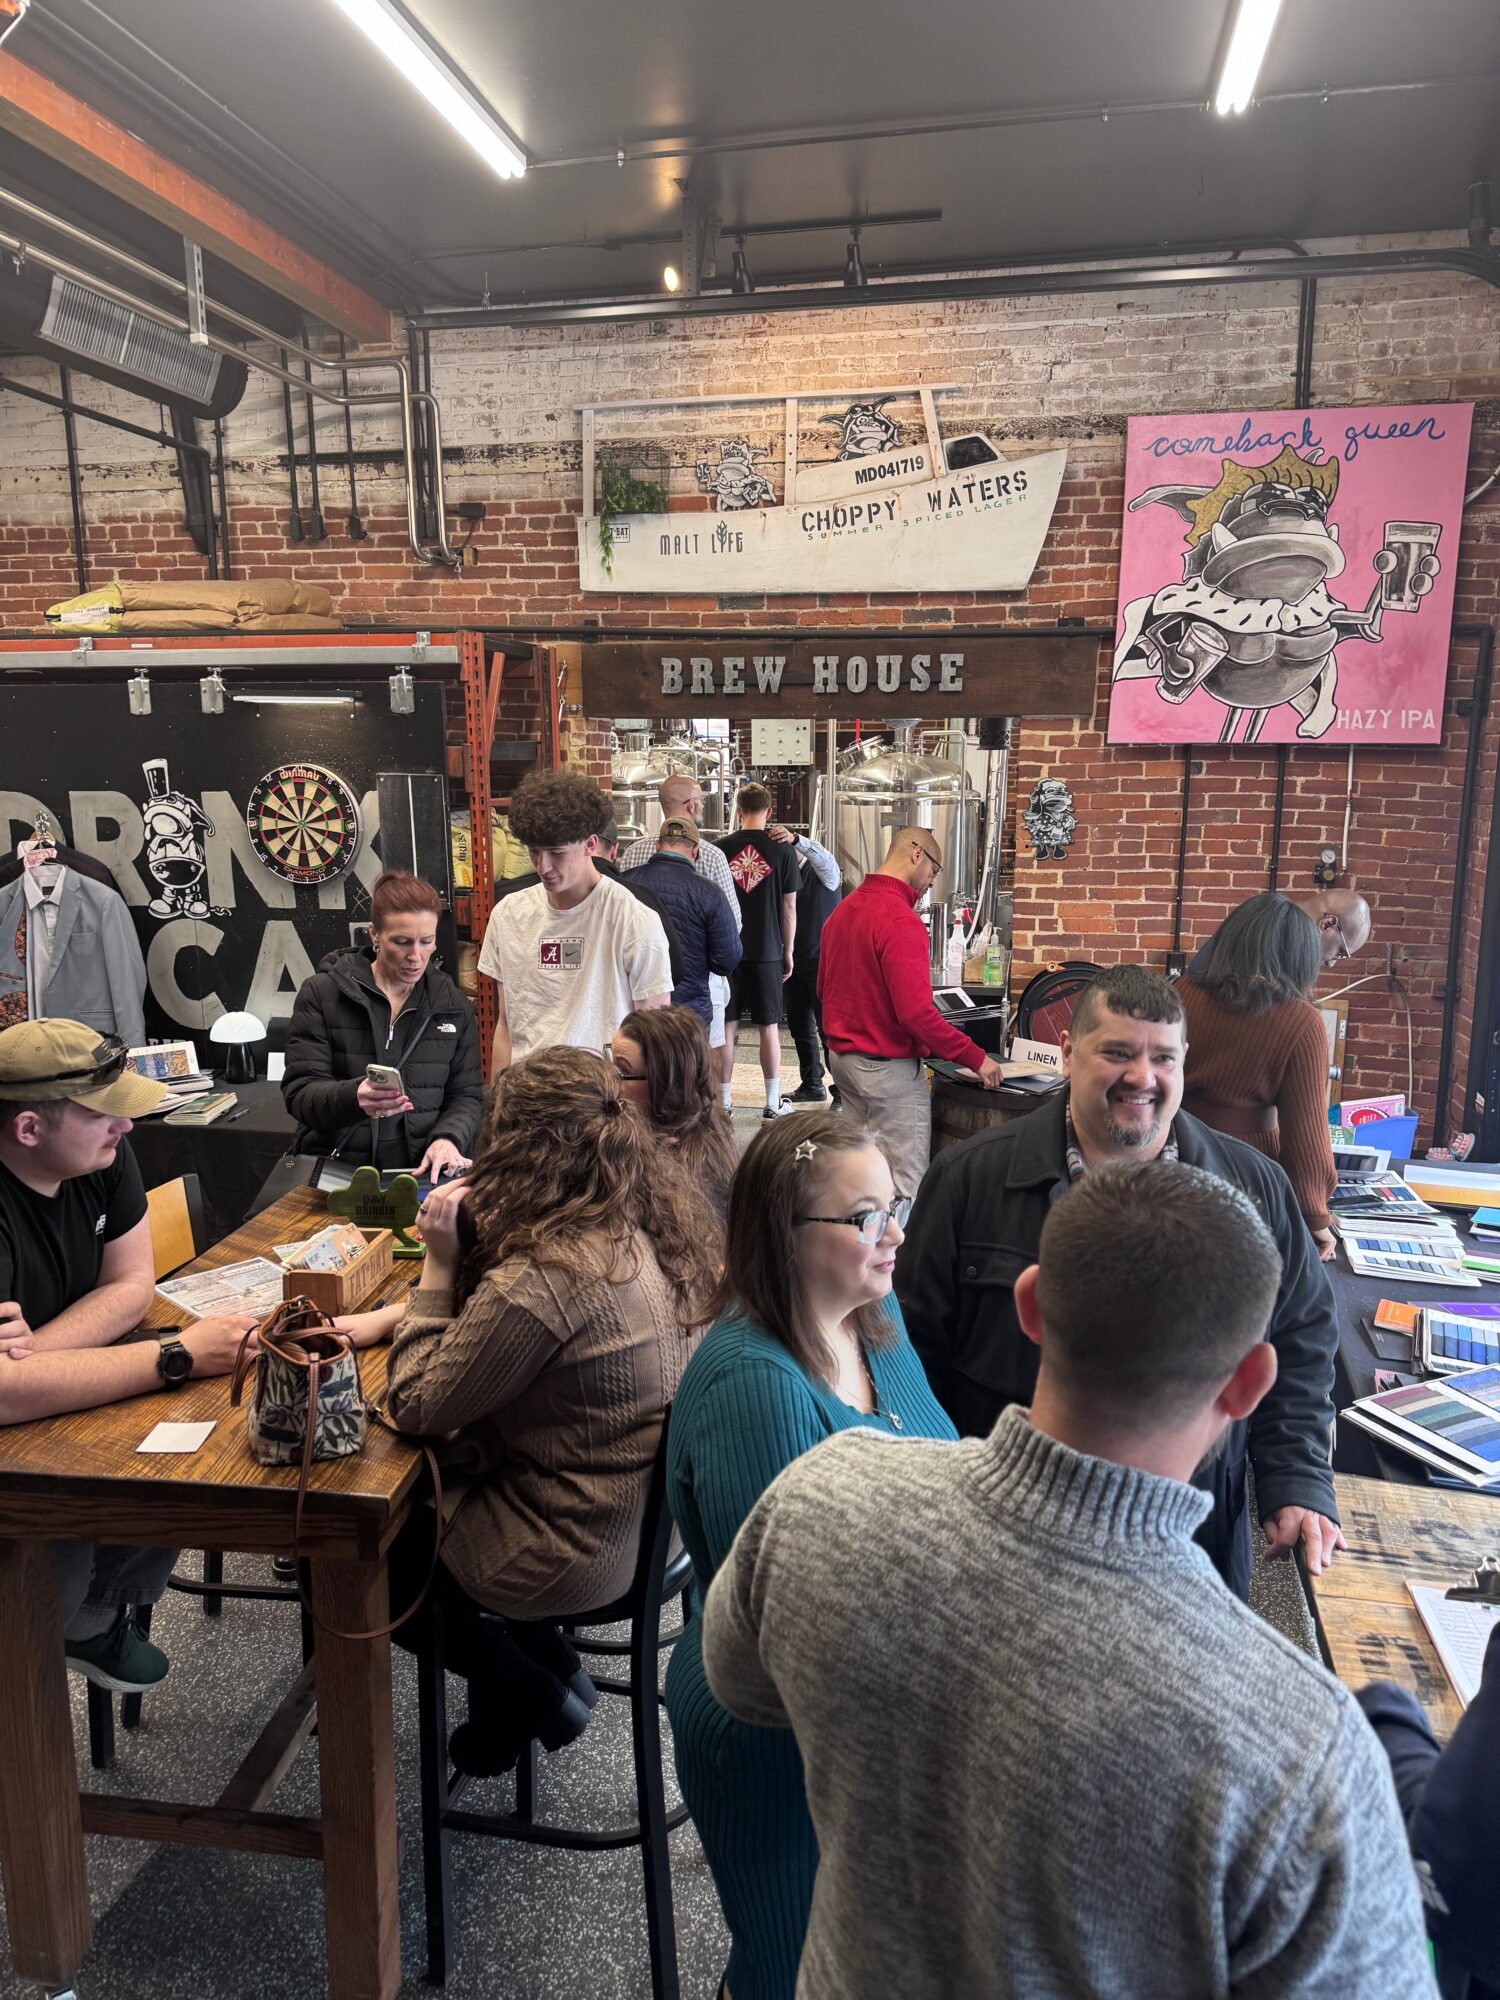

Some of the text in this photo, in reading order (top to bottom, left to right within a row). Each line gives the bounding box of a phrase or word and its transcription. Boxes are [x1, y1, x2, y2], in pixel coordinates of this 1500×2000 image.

[1142, 416, 1447, 461] comeback queen
[854, 455, 925, 485] MD041719
[801, 470, 1029, 533] CHOPPY WATERS
[807, 494, 1027, 541] SUMMER SPICED LAGER
[660, 534, 699, 556] MALT
[660, 653, 964, 695] BREW HOUSE
[1336, 708, 1436, 729] HAZY IPA
[458, 832, 467, 861] BRIES
[543, 946, 557, 961] A
[1027, 1051, 1057, 1065] LINEN
[1329, 1127, 1344, 1138] LE
[350, 1262, 367, 1301] FAT
